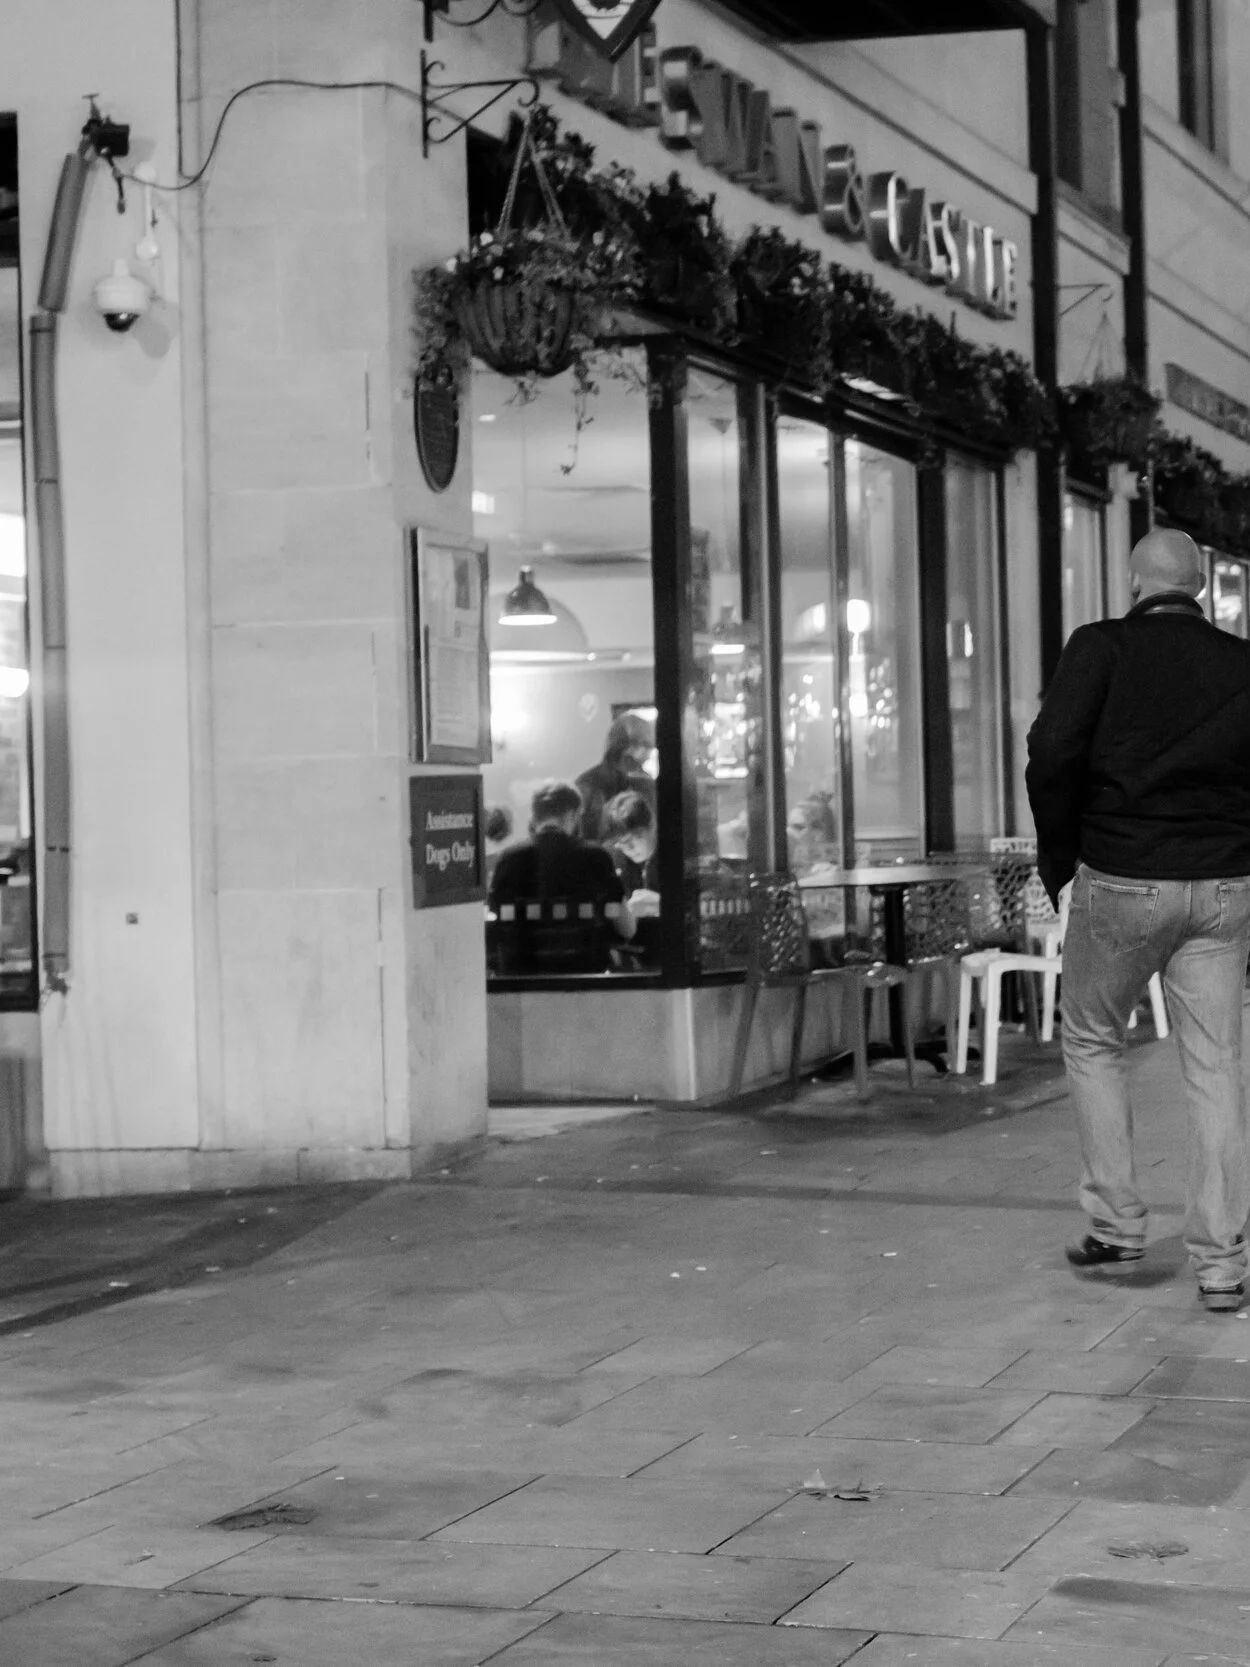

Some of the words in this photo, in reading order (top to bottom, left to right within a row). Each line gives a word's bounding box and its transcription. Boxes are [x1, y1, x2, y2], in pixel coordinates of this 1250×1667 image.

[425, 810, 473, 831] Assistance
[426, 843, 451, 872] Dogs
[451, 841, 475, 868] Only
